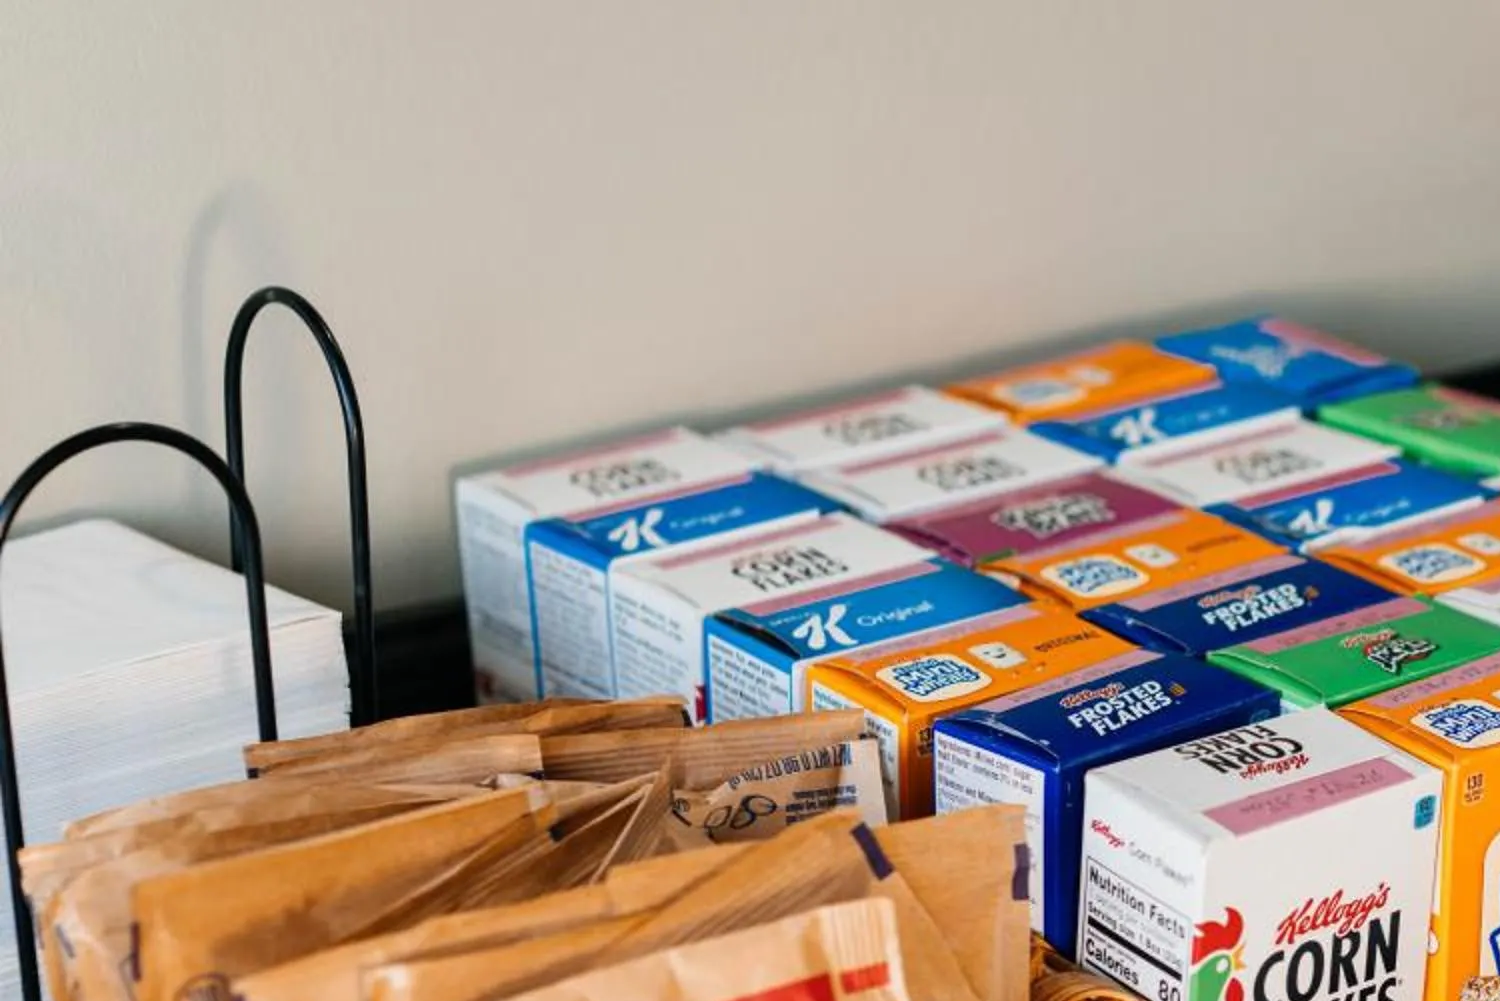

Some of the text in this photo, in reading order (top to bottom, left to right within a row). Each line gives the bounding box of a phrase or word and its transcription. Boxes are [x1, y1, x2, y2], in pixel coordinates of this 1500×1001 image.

[731, 547, 834, 578] CORN
[751, 561, 849, 592] FLAKES
[792, 603, 859, 650] K
[856, 600, 935, 627] Original
[1202, 583, 1297, 626] FROSTED
[1223, 597, 1305, 632] FLAKES
[1067, 680, 1162, 728] FROSTED
[1091, 691, 1172, 737] FLAKES
[1173, 724, 1279, 762] FLAKES
[1201, 737, 1304, 774] CORN
[1090, 864, 1145, 915] Nutrition
[1149, 903, 1186, 939] Facts
[1275, 882, 1392, 946] Kellogg's
[1086, 938, 1140, 986] Calories
